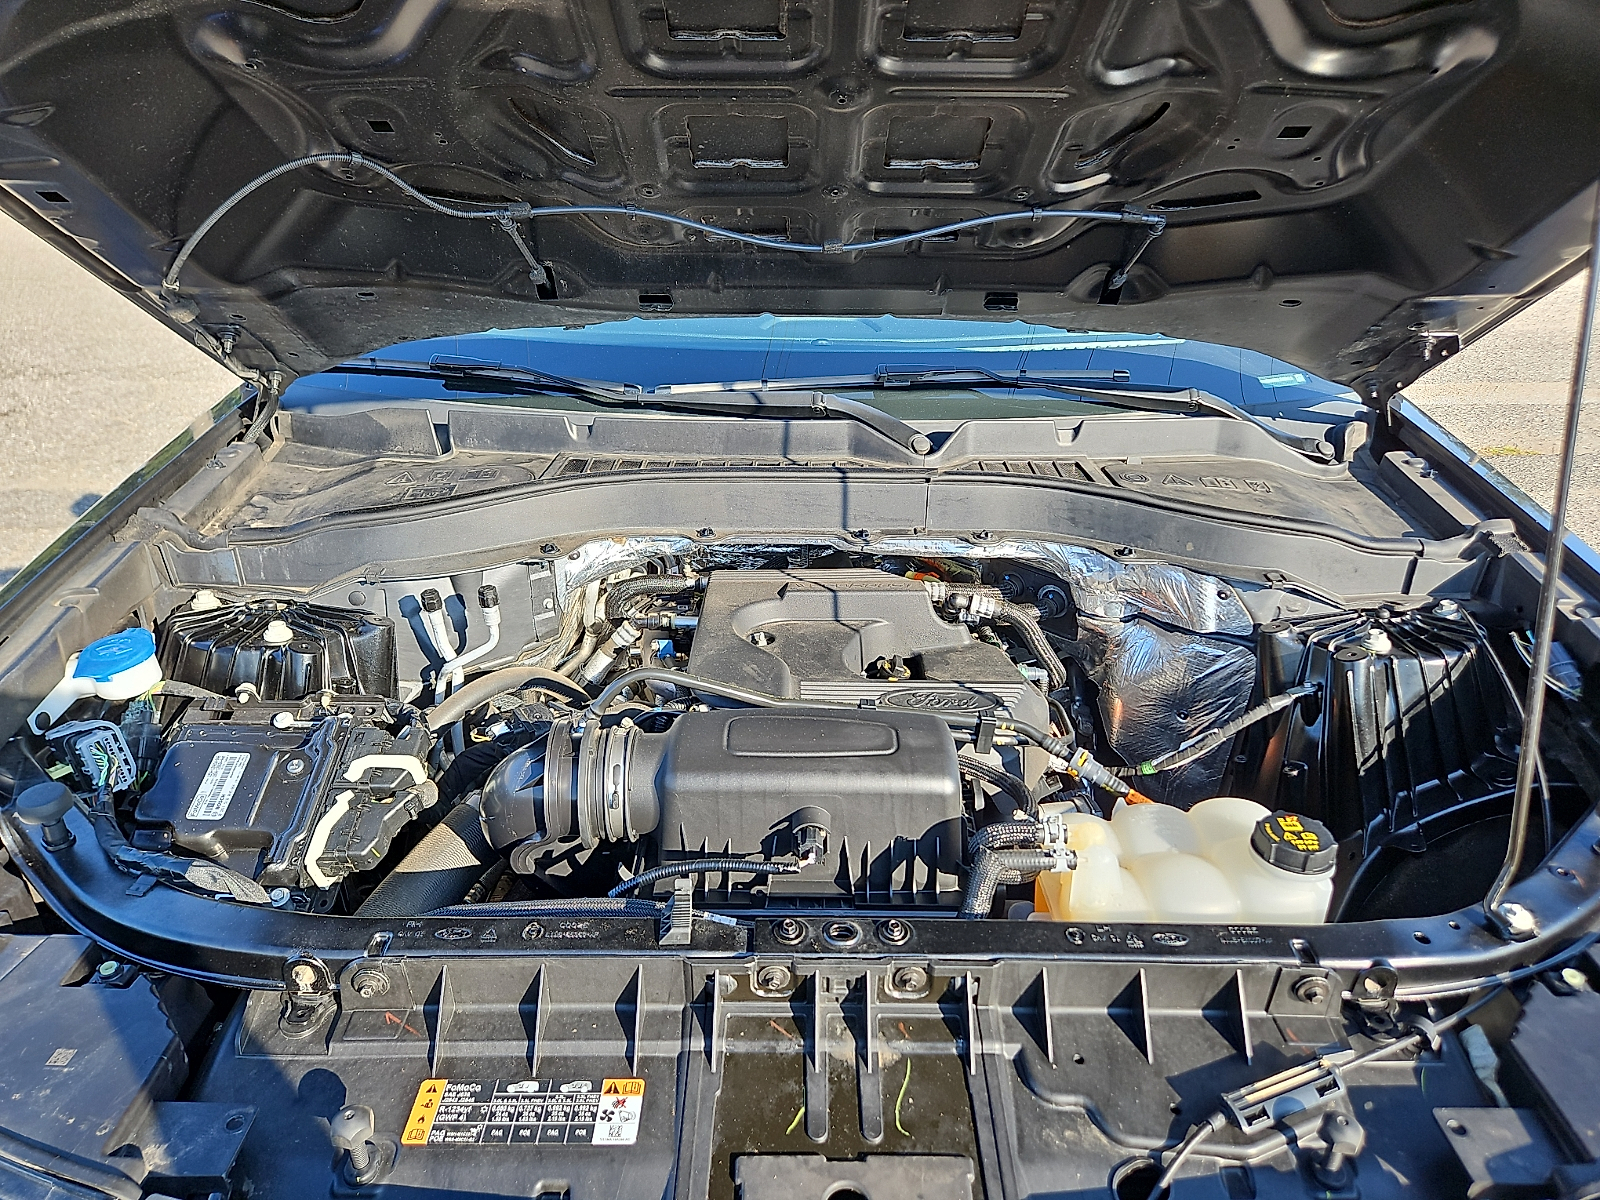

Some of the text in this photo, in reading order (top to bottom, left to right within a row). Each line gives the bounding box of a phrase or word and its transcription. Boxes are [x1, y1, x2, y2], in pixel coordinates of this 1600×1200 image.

[906, 692, 980, 709] Ford
[445, 1083, 482, 1092] FoMoCo
[439, 1105, 473, 1114] R-1234yf
